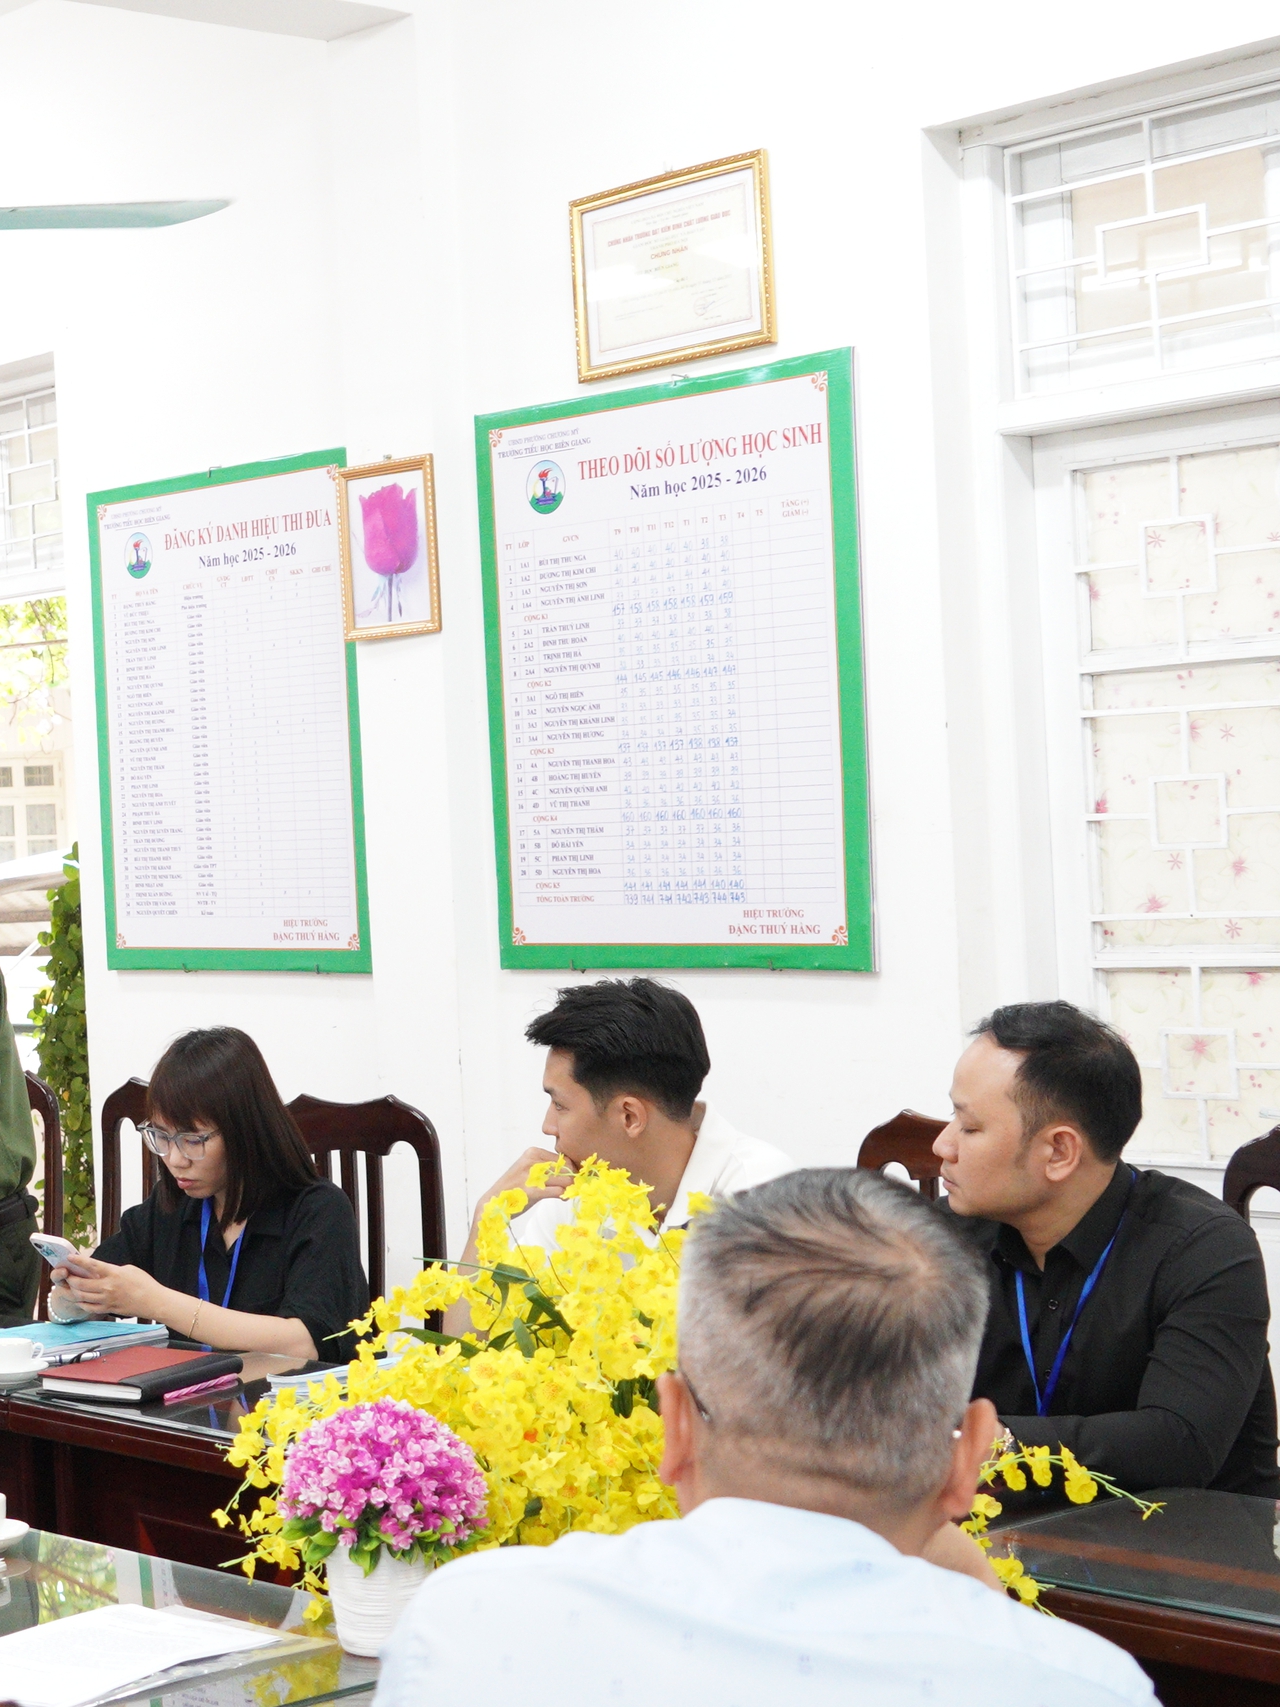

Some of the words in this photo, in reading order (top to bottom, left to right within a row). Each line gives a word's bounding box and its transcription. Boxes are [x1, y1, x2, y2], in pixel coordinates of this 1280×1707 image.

[540, 443, 554, 453] HỌC
[571, 437, 591, 448] GIANG
[578, 455, 620, 480] THEO
[623, 447, 652, 474] DÕI
[655, 440, 675, 469] SỐ
[680, 436, 737, 467] LƯỢNG
[741, 430, 778, 458] HỌC
[782, 422, 822, 449] SINH
[629, 484, 660, 501] Năm
[664, 480, 687, 497] học
[691, 472, 721, 491] 2025
[735, 465, 767, 485] 2026
[781, 500, 800, 508] TĂNG
[701, 516, 708, 524] T2
[737, 511, 745, 519] T4
[164, 528, 195, 550] ĐĂNG
[198, 521, 213, 545] KÝ
[216, 521, 248, 542] DANH
[251, 514, 279, 540] HIỆU
[281, 513, 304, 533] THI
[306, 509, 332, 529] ĐUA
[664, 521, 674, 529] T12
[198, 554, 221, 569] Năm
[223, 552, 240, 567] học
[242, 547, 264, 563] 2025
[273, 542, 297, 558] 2026
[549, 557, 560, 566] THỊ
[564, 583, 575, 591] THỊ
[565, 596, 576, 604] THỊ
[590, 593, 605, 601] LINH
[575, 622, 590, 630] LINH
[568, 854, 579, 862] THỊ
[577, 868, 587, 876] THỊ
[743, 908, 764, 920] HIỆU
[766, 907, 804, 918] TRƯỞNG
[283, 918, 298, 929] HIỆU
[759, 921, 788, 934] THUÝ
[295, 930, 315, 941] THUÝ
